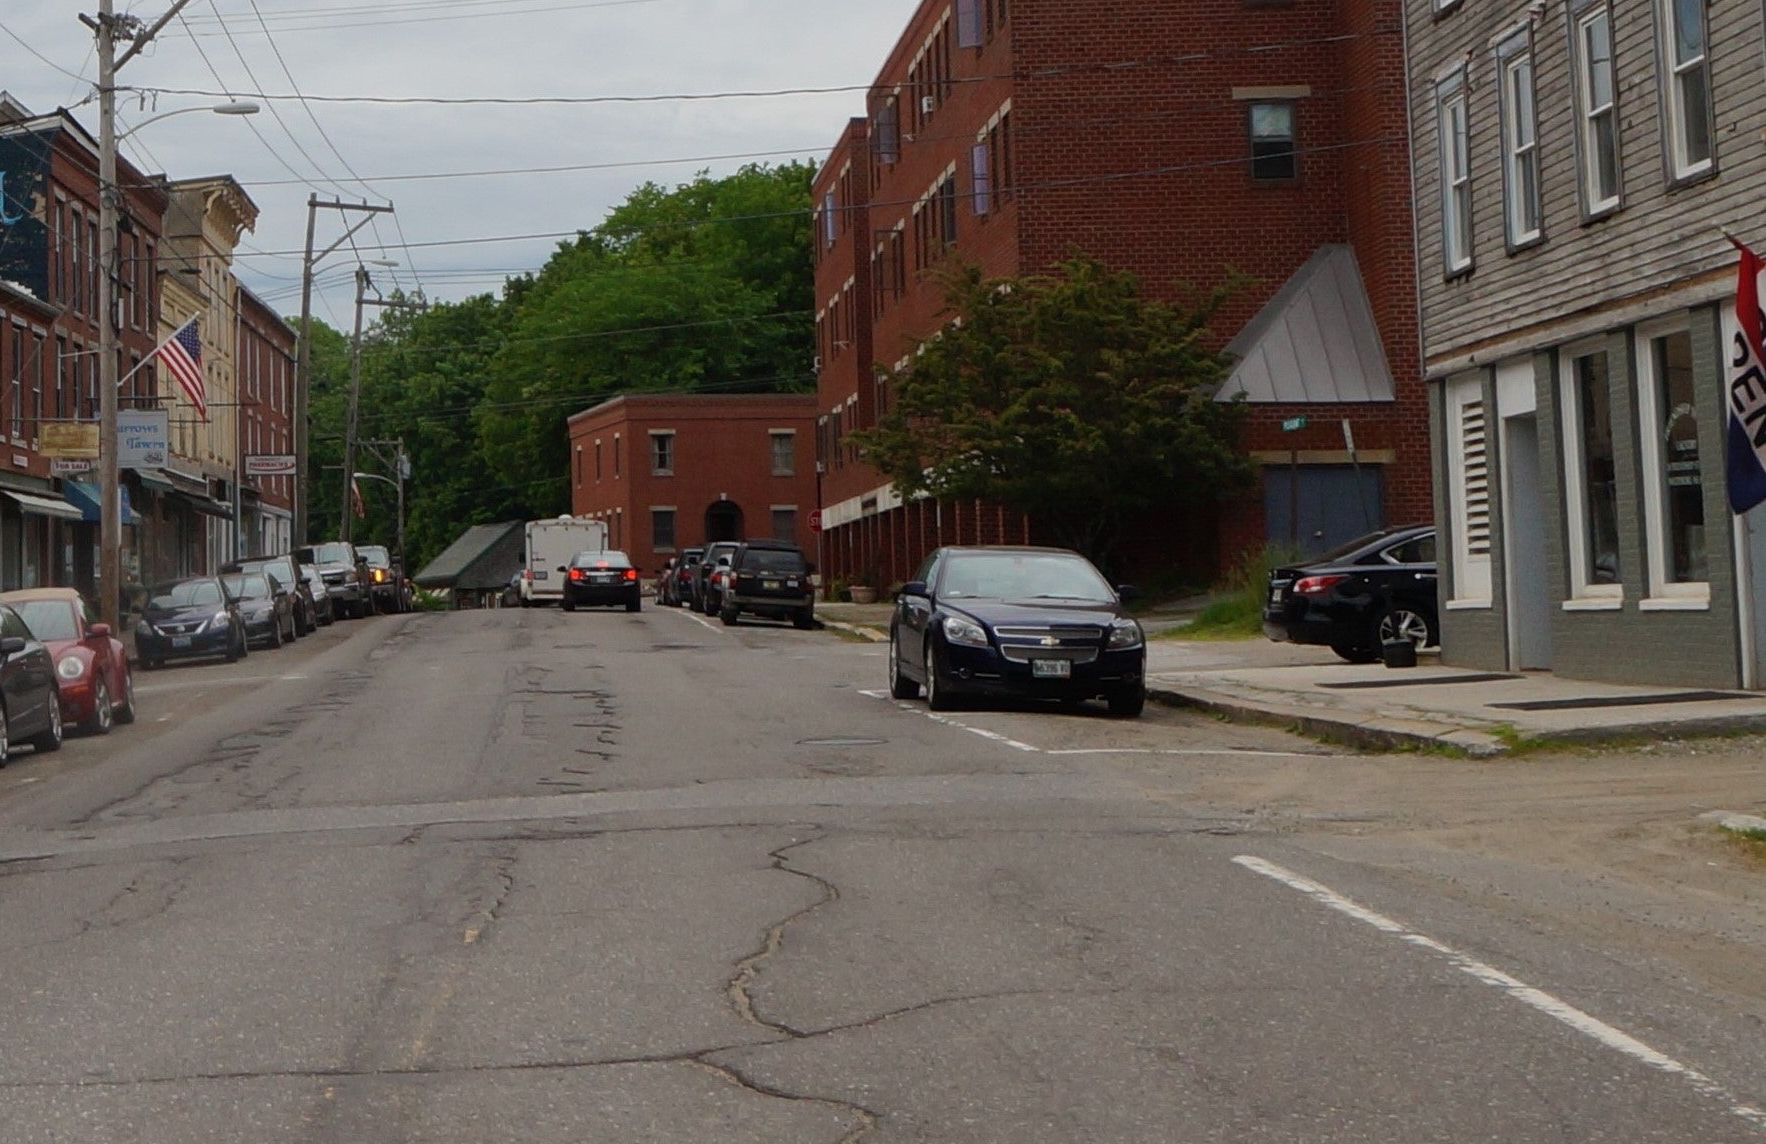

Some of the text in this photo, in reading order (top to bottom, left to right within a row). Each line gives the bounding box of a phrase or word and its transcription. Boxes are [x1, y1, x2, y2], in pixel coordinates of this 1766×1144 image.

[126, 437, 165, 449] Tavern
[56, 461, 88, 470] FOR SALE
